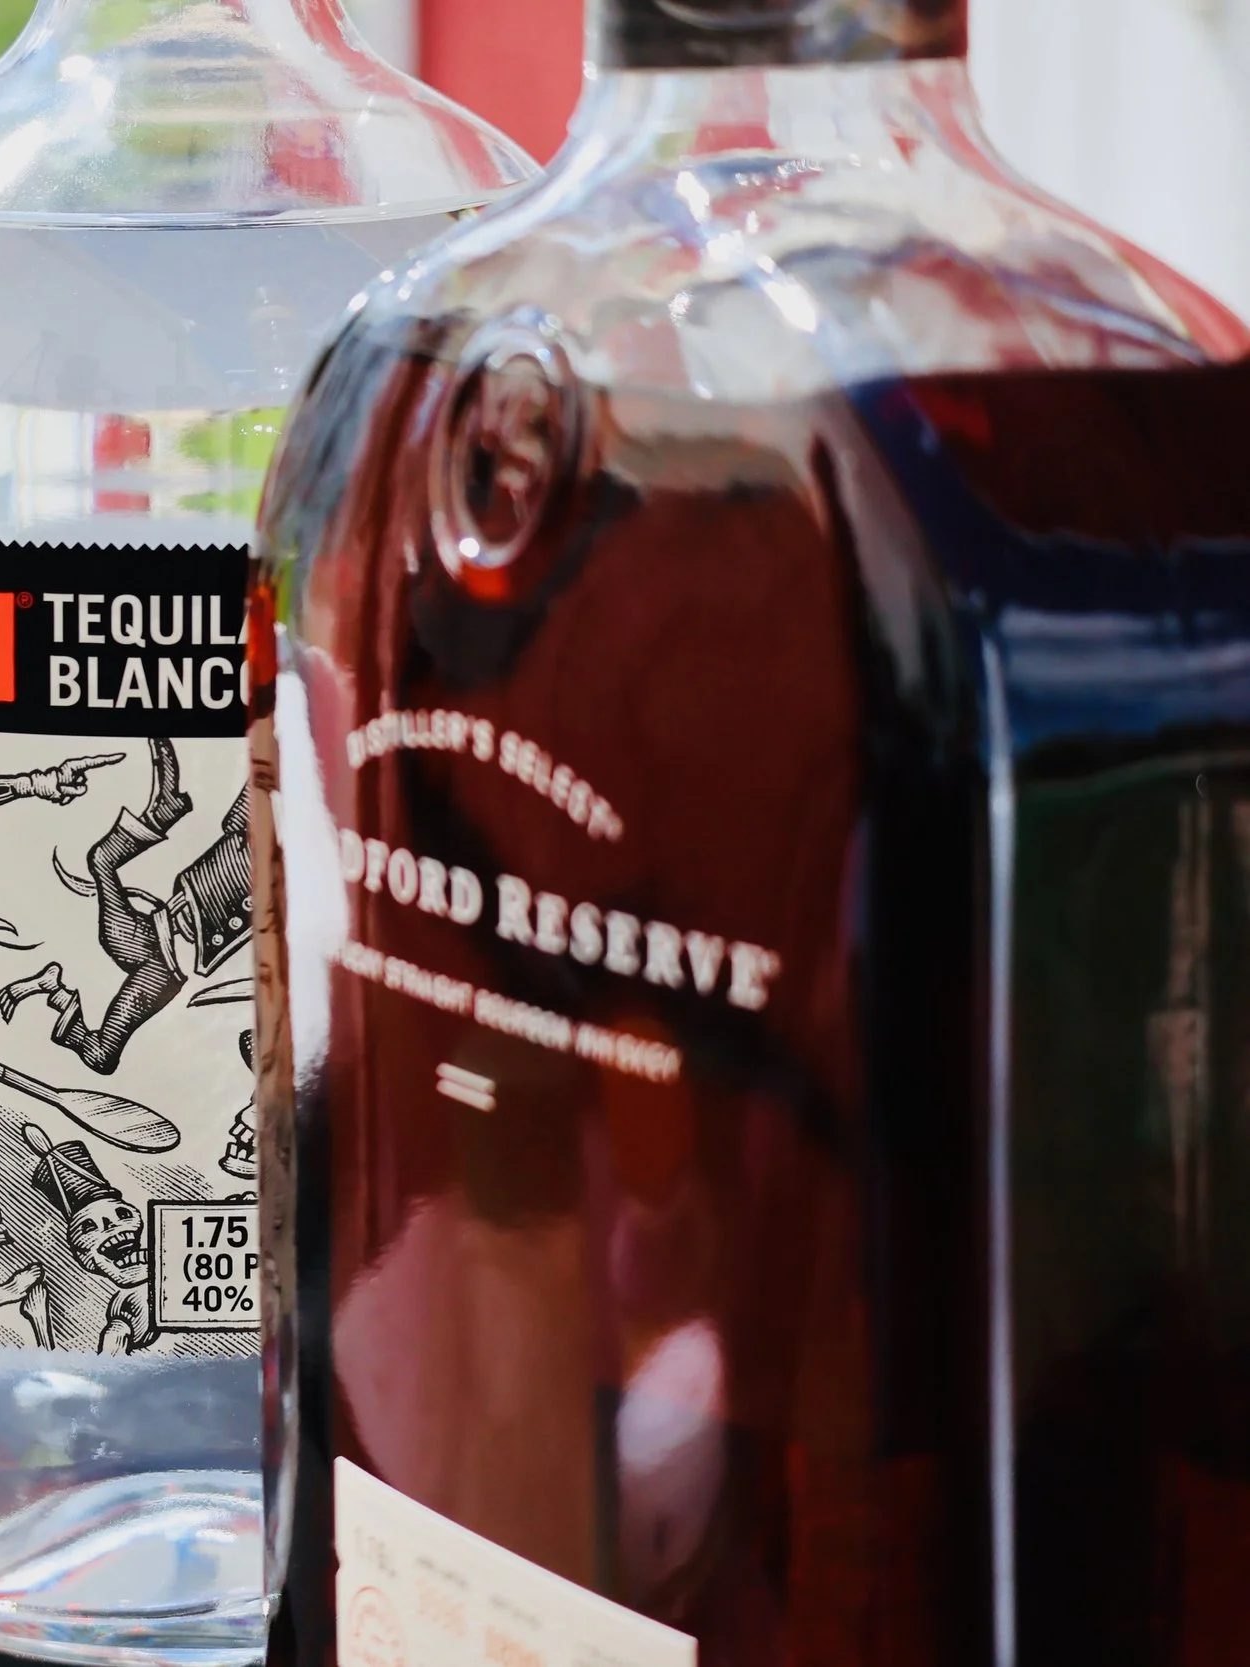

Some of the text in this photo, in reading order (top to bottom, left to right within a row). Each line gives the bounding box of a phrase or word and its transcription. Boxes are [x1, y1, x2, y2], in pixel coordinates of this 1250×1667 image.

[496, 874, 770, 1011] RESERVE
[182, 1216, 248, 1248] 1.75
[183, 1253, 233, 1282] (80
[182, 1285, 254, 1312] 40%
